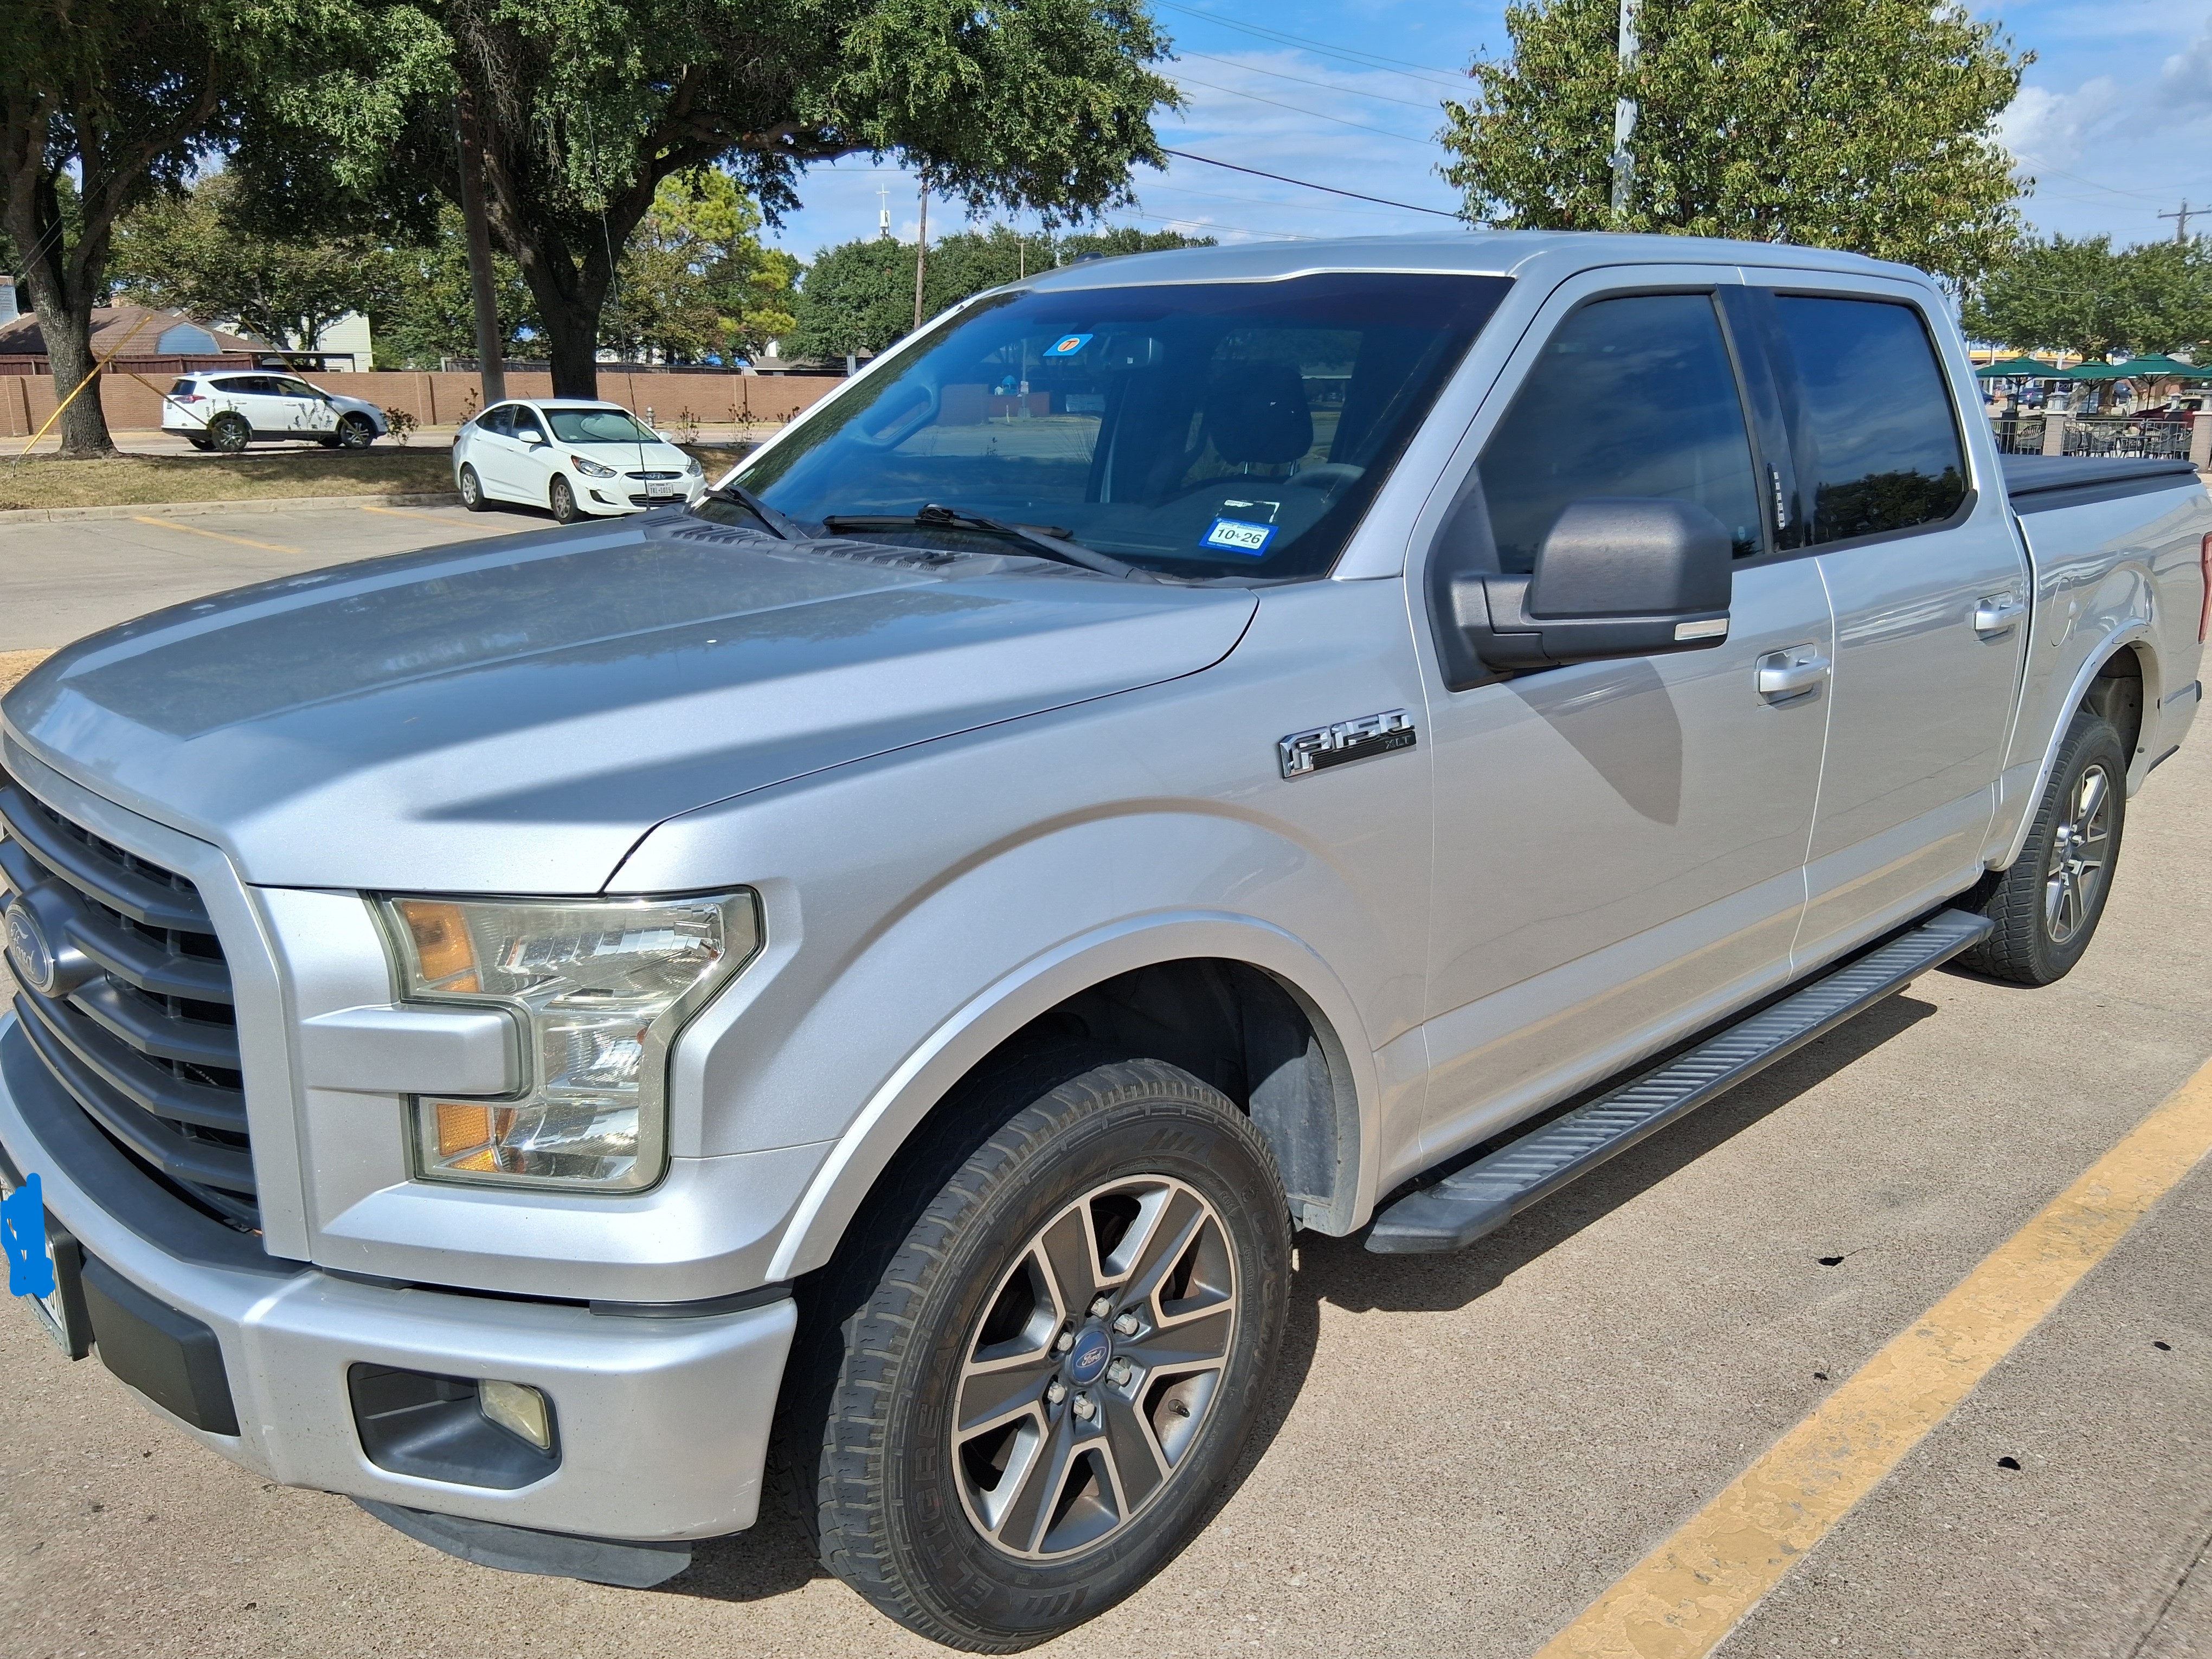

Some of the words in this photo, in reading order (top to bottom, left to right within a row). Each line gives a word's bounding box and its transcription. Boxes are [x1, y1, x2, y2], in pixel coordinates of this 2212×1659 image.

[1218, 529, 1236, 539] 10
[1240, 532, 1262, 544] 26
[1385, 735, 1411, 749] XLT
[10, 921, 36, 975] Ford
[1081, 1350, 1102, 1366] Ford
